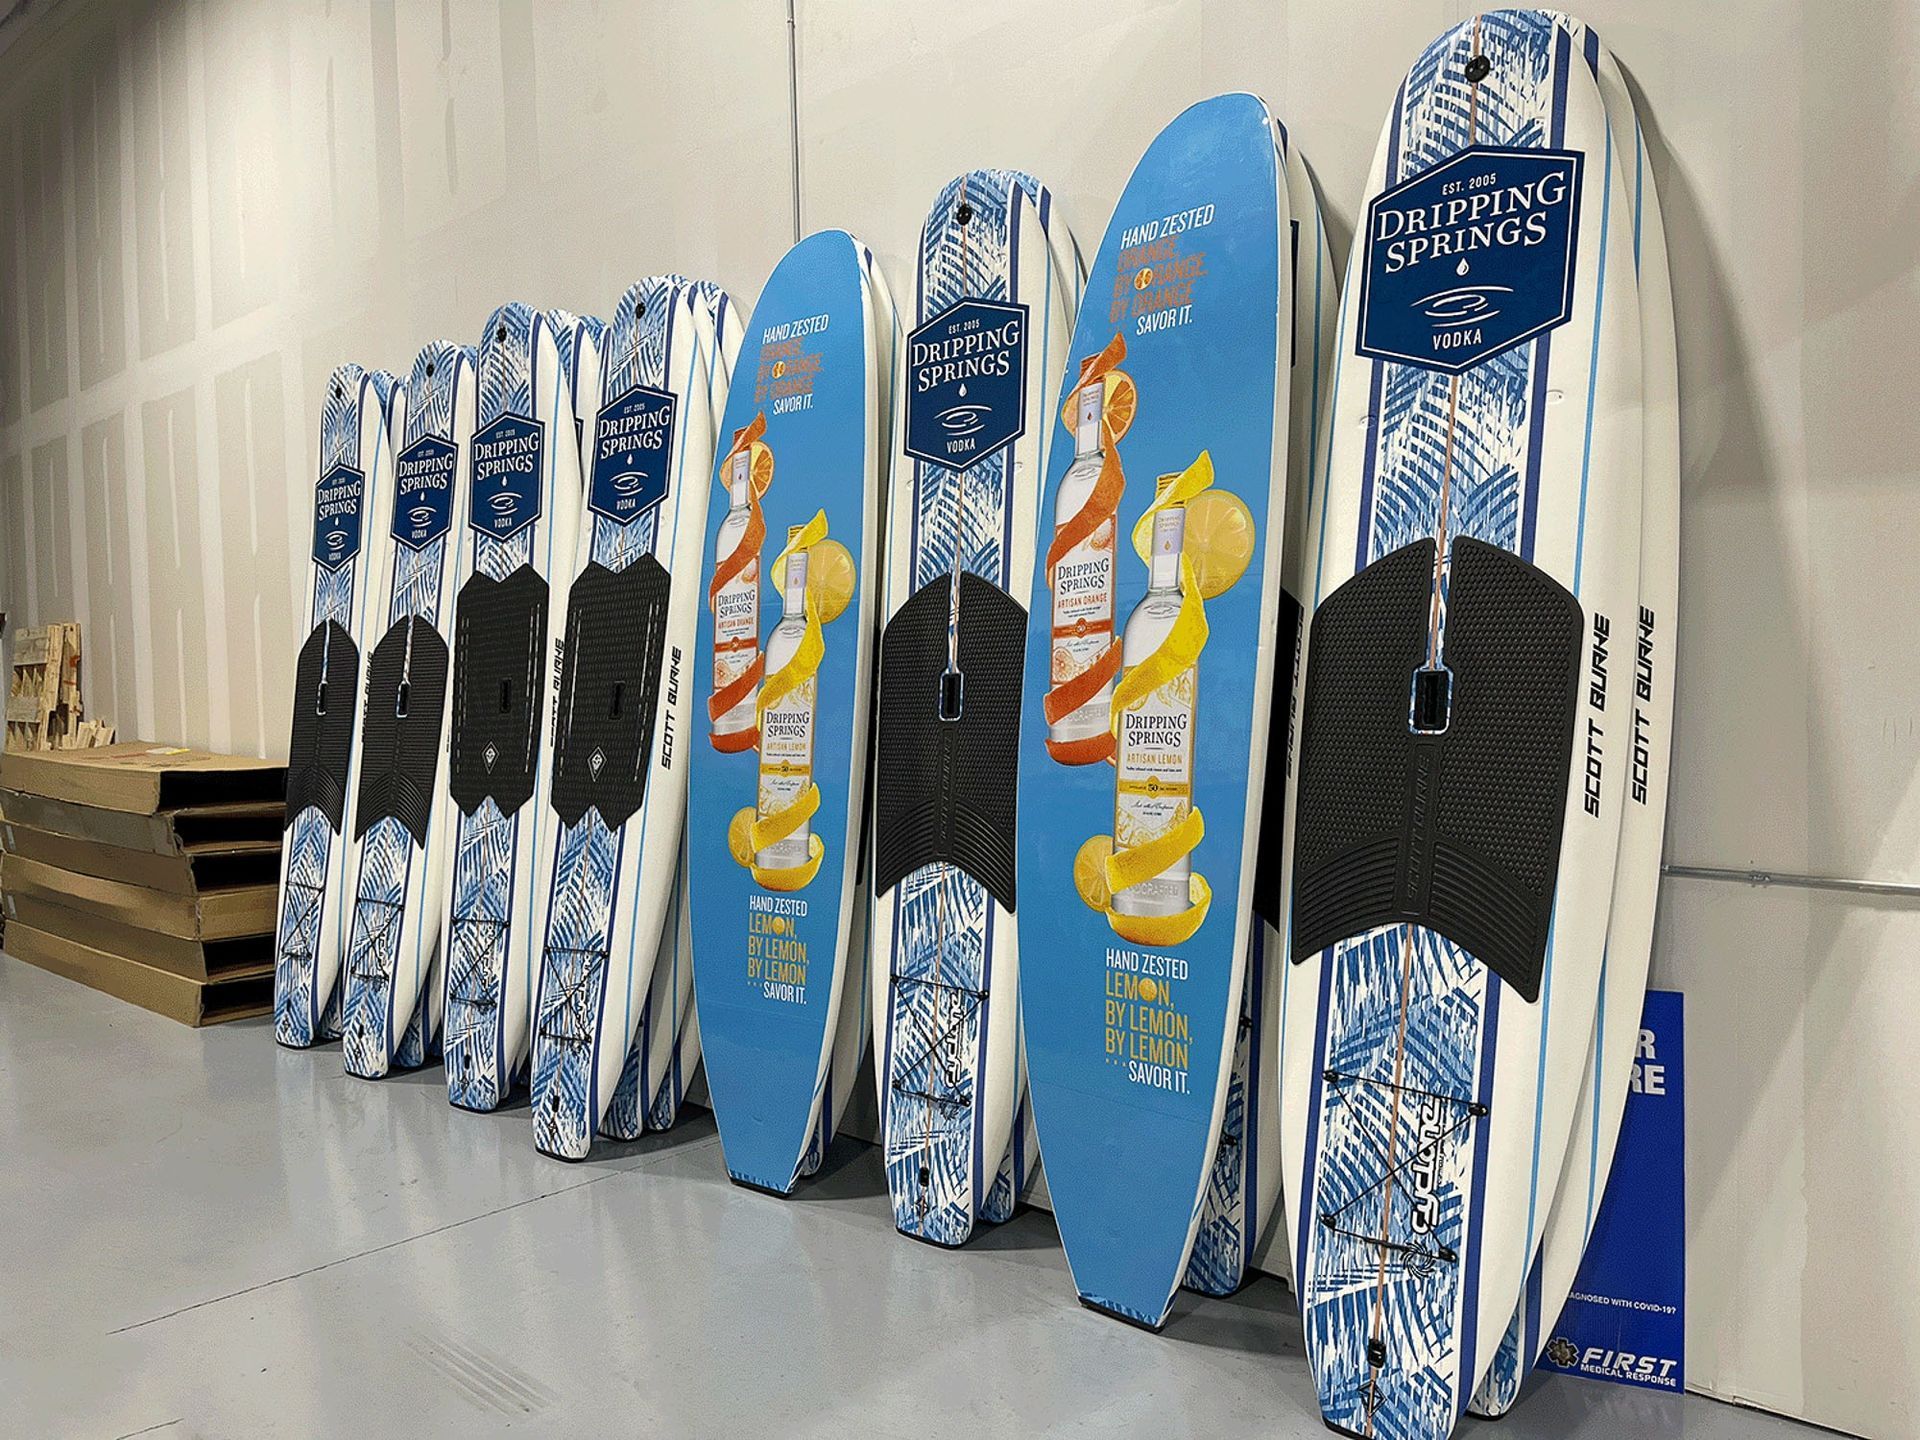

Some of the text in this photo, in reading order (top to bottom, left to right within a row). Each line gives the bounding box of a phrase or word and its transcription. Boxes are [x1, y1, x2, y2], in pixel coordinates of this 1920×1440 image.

[1442, 172, 1497, 196] EST. 2005
[1376, 171, 1567, 241] DRIPPING
[1121, 204, 1215, 250] HAND ZESTED
[1385, 210, 1547, 274] SPRINGS
[762, 314, 829, 345] HAND ZESTED
[1136, 304, 1193, 336] SAVOR IT.
[912, 320, 1020, 367] DRIPPING
[1432, 328, 1482, 350] VODKA
[918, 350, 1010, 392] SPRINGS
[772, 394, 814, 415] SAVOR IT.
[599, 406, 670, 439] DRIPPING
[474, 432, 539, 461] DRIPPING
[601, 429, 663, 459] SPRINGS
[946, 438, 976, 454] VODKA
[399, 453, 453, 476] DRIPPING
[477, 454, 533, 480] SPRINGS
[318, 480, 360, 504] DRIPPING
[400, 472, 447, 495] SPRINGS
[319, 499, 356, 520] SPRINGS
[1058, 558, 1109, 580] DRIPPING
[1060, 574, 1104, 595] SPRINGS
[718, 590, 755, 606] DRIPPING
[662, 646, 682, 770] SCOTT BURKE
[766, 711, 809, 724] DRIPPING
[1584, 612, 1610, 818] SCOTT BURKE
[1632, 605, 1654, 806] SCOTT BURKE
[768, 725, 805, 738] SPRINGS
[1126, 713, 1187, 730] DRIPPING
[1128, 731, 1181, 747] SPRINGS
[749, 895, 808, 917] HAND ZESTED
[748, 936, 810, 965] BY LEMON,
[748, 957, 806, 986] BY LEMON
[1106, 948, 1188, 980] HAND ZESTED
[796, 987, 807, 1005] IT.
[1106, 1000, 1193, 1045] BY LEMON,
[1106, 1028, 1188, 1071] BY LEMON
[1175, 1072, 1191, 1094] IT.
[1610, 1298, 1632, 1308] WITH
[1634, 1302, 1676, 1314] COVID-19?
[1582, 1347, 1678, 1377] FIRST
[1581, 1364, 1676, 1387] MEDICAL RESPONSE
